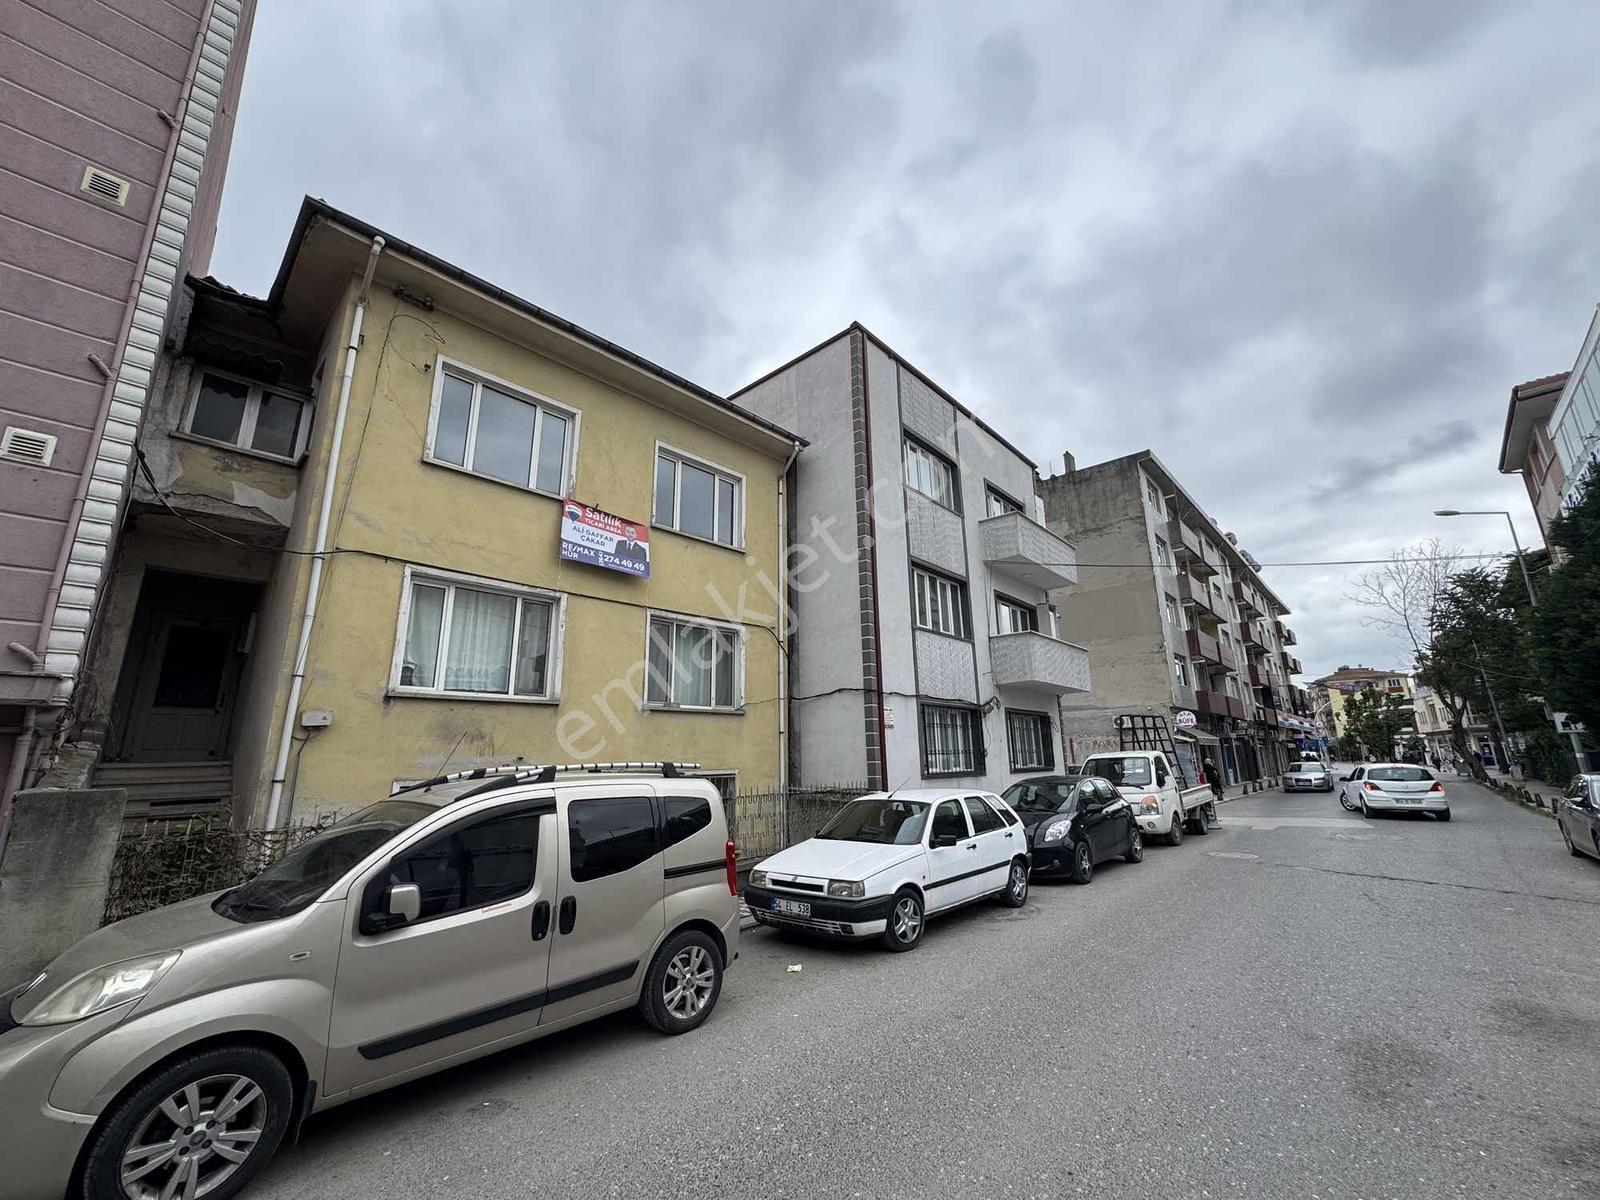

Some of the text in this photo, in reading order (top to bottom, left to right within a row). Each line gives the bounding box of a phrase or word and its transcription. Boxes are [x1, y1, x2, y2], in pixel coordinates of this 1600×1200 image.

[585, 507, 622, 528] Satılık
[586, 529, 614, 542] GAFFAR
[562, 541, 595, 557] RE/MAX
[604, 555, 620, 565] 274
[621, 559, 633, 567] 49
[634, 562, 645, 571] 49
[786, 901, 793, 912] EL
[798, 903, 809, 914] 538
